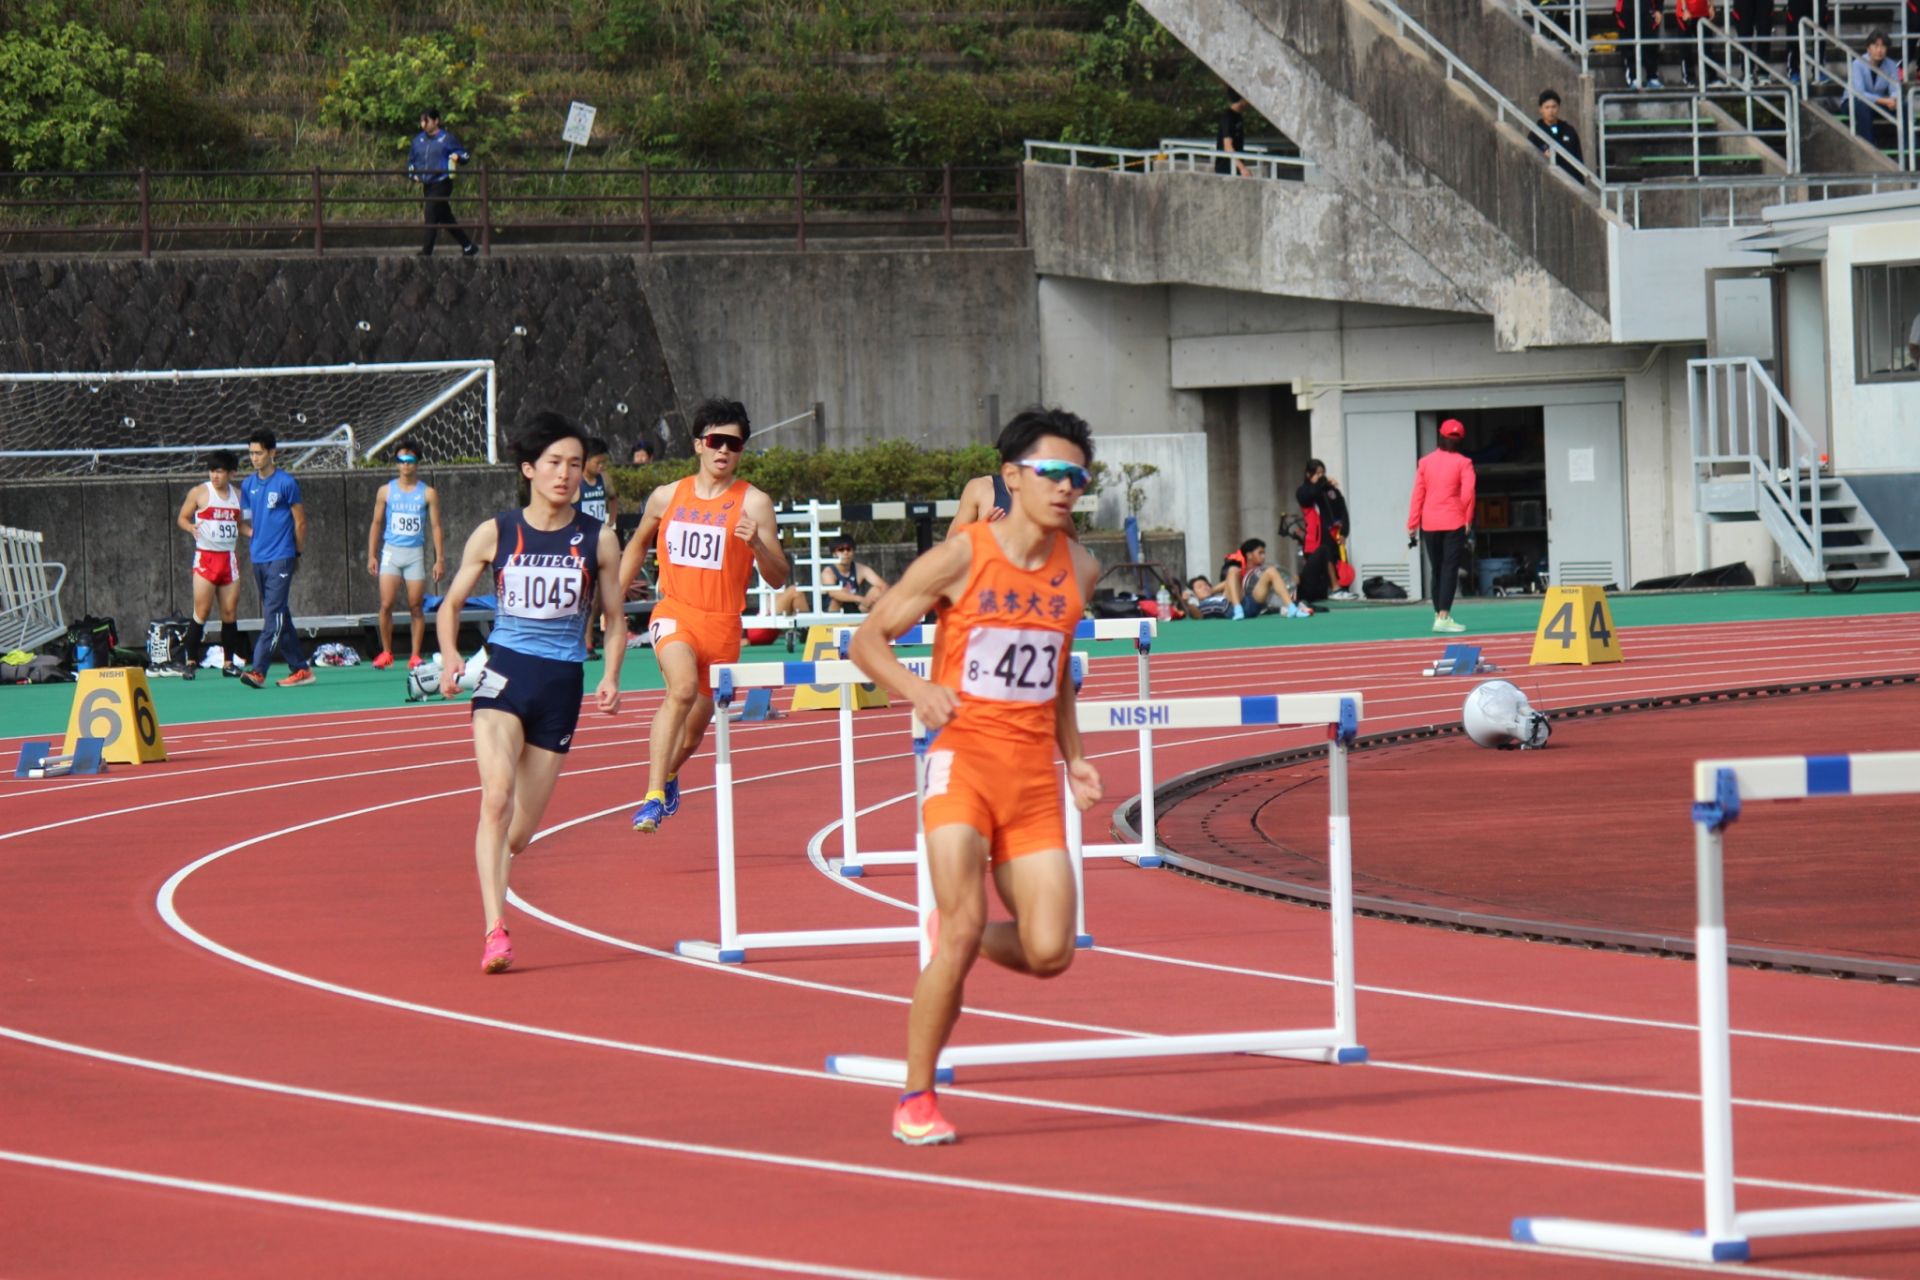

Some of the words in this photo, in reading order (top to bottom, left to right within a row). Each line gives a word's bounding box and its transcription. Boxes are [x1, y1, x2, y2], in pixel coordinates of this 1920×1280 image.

[506, 553, 586, 569] KYUTECH
[508, 576, 577, 610] 8-1045
[977, 588, 1067, 619] 熊本大学
[1544, 602, 1577, 648] 4
[1589, 601, 1611, 648] 4
[968, 643, 1057, 688] 8-423
[78, 688, 122, 748] 6
[133, 687, 156, 746] 6
[1109, 705, 1169, 726] NISHI
